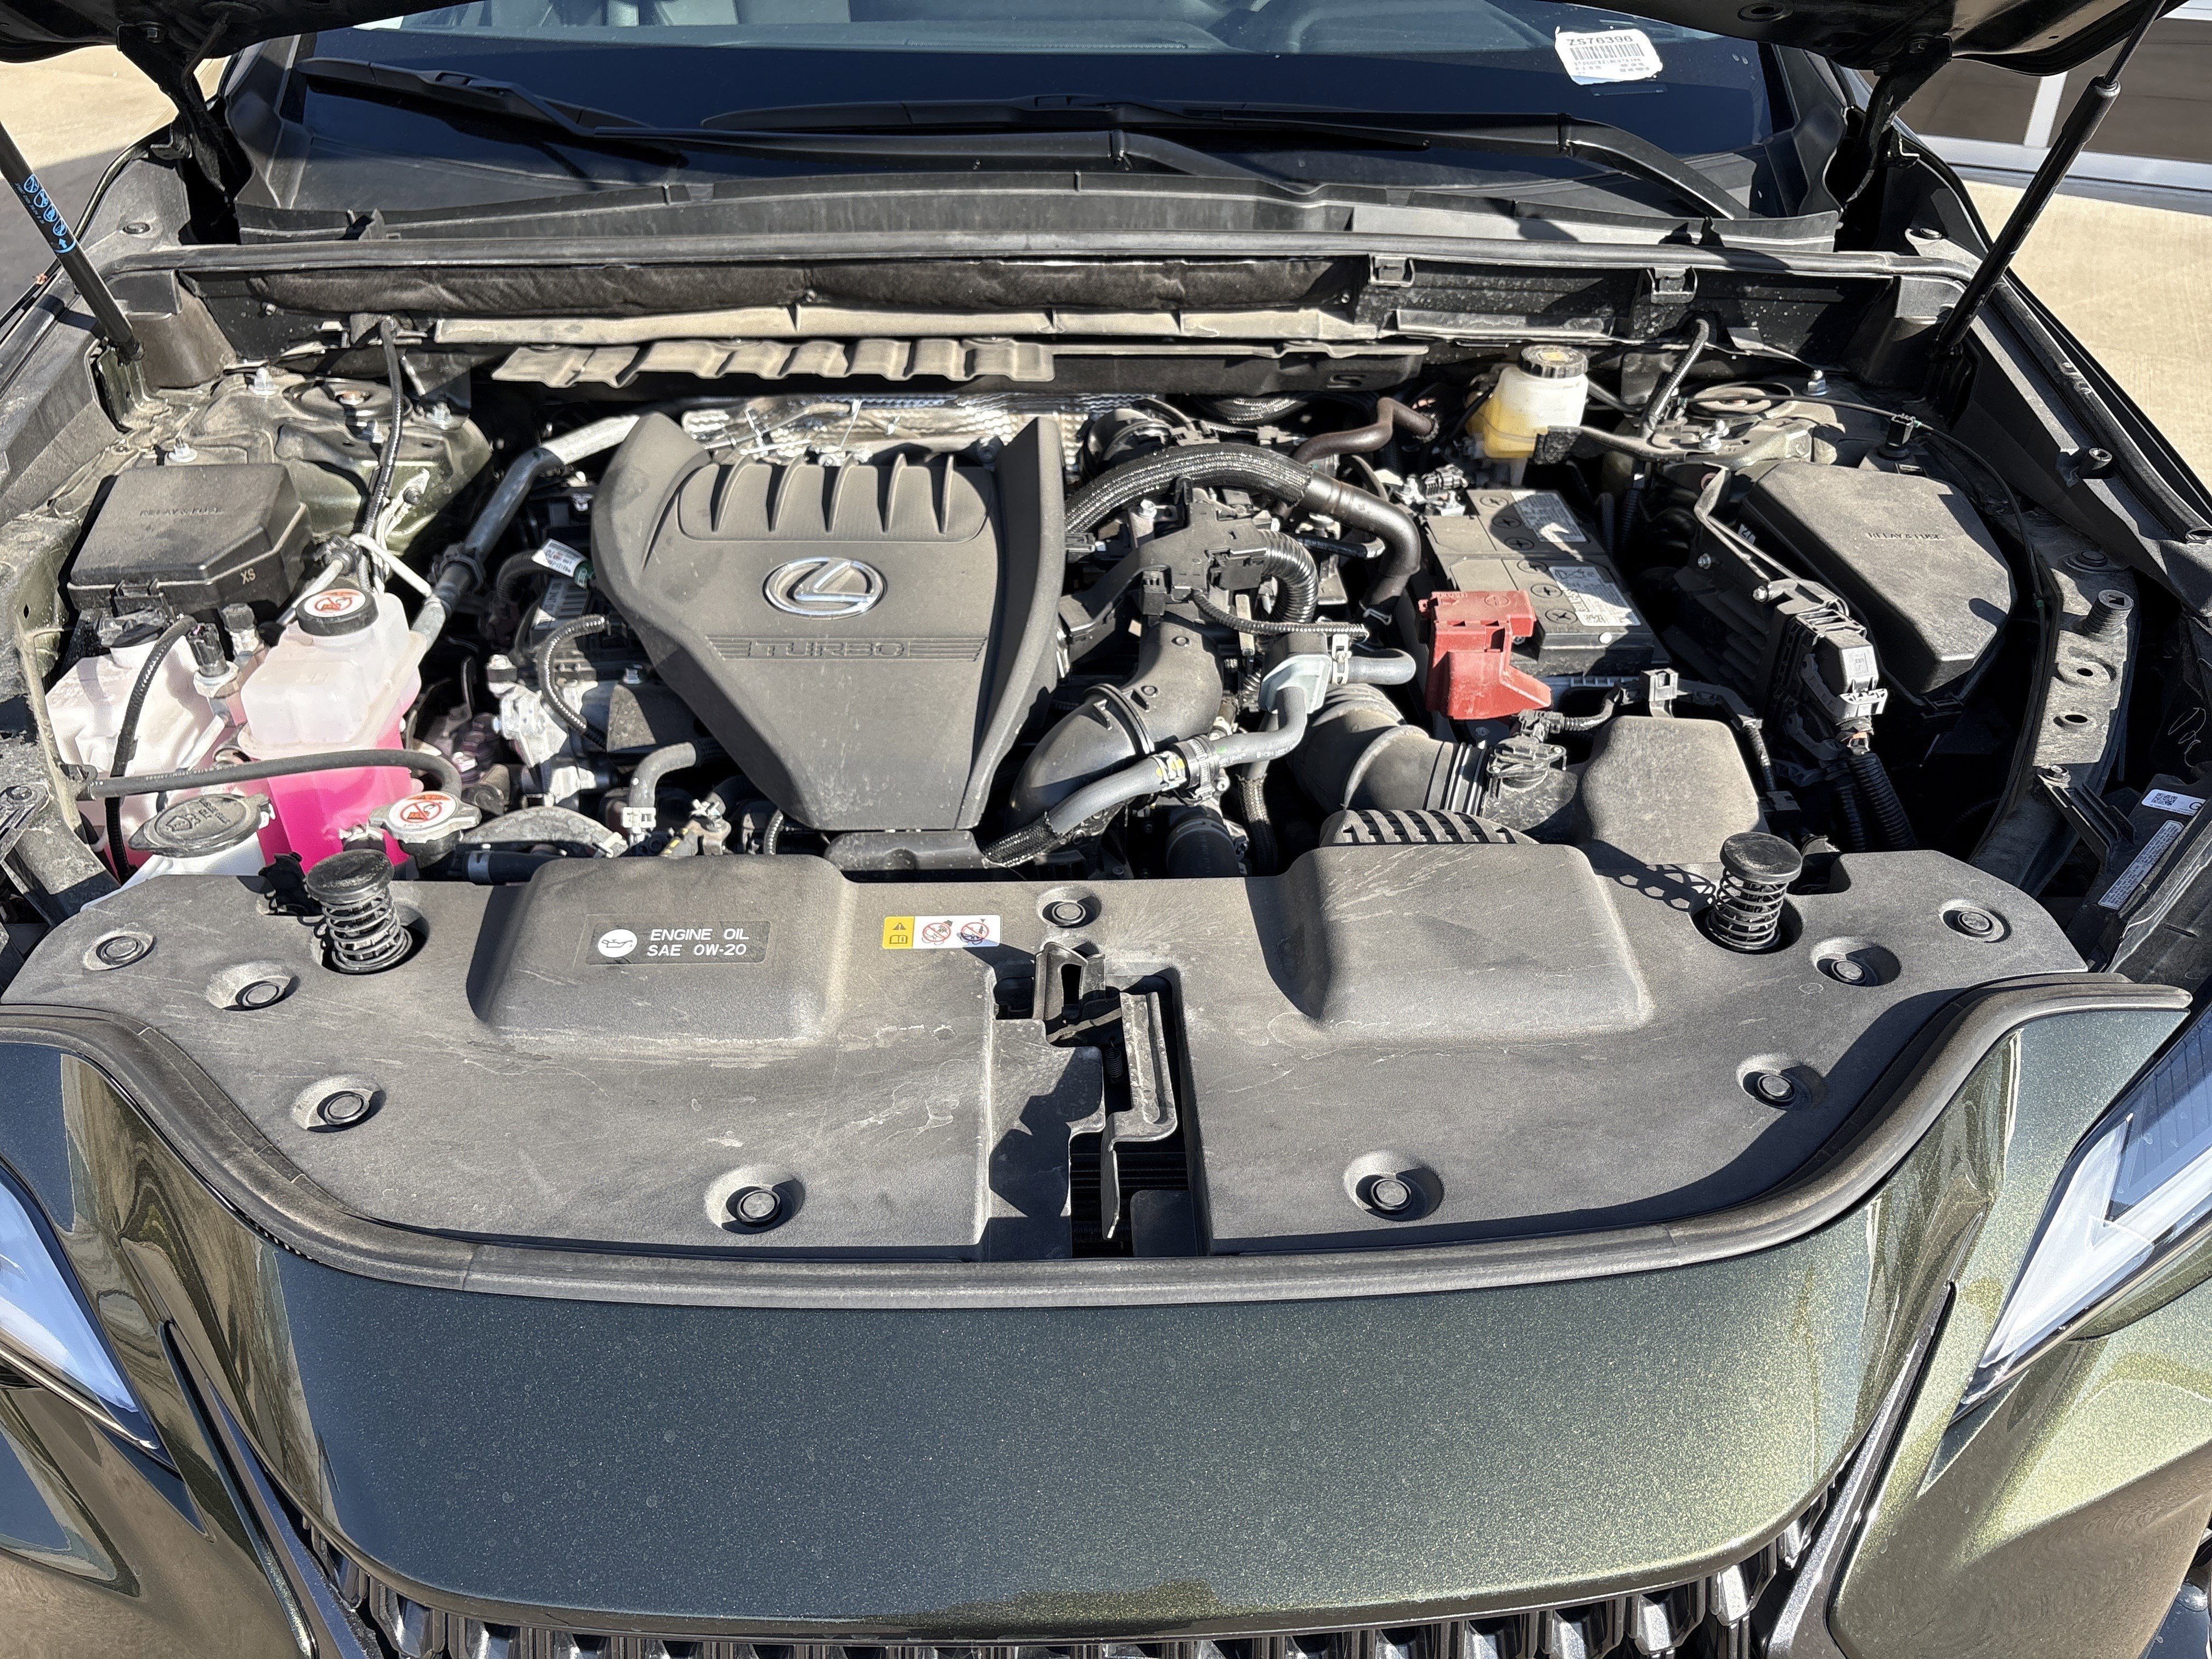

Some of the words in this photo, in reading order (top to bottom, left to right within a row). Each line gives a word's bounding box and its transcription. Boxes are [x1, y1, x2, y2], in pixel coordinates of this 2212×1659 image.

[755, 641, 905, 657] TURBO
[650, 928, 713, 941] ENGINE
[723, 928, 750, 940] OIL
[647, 944, 684, 957] SAE
[693, 943, 747, 956] 0W-20
